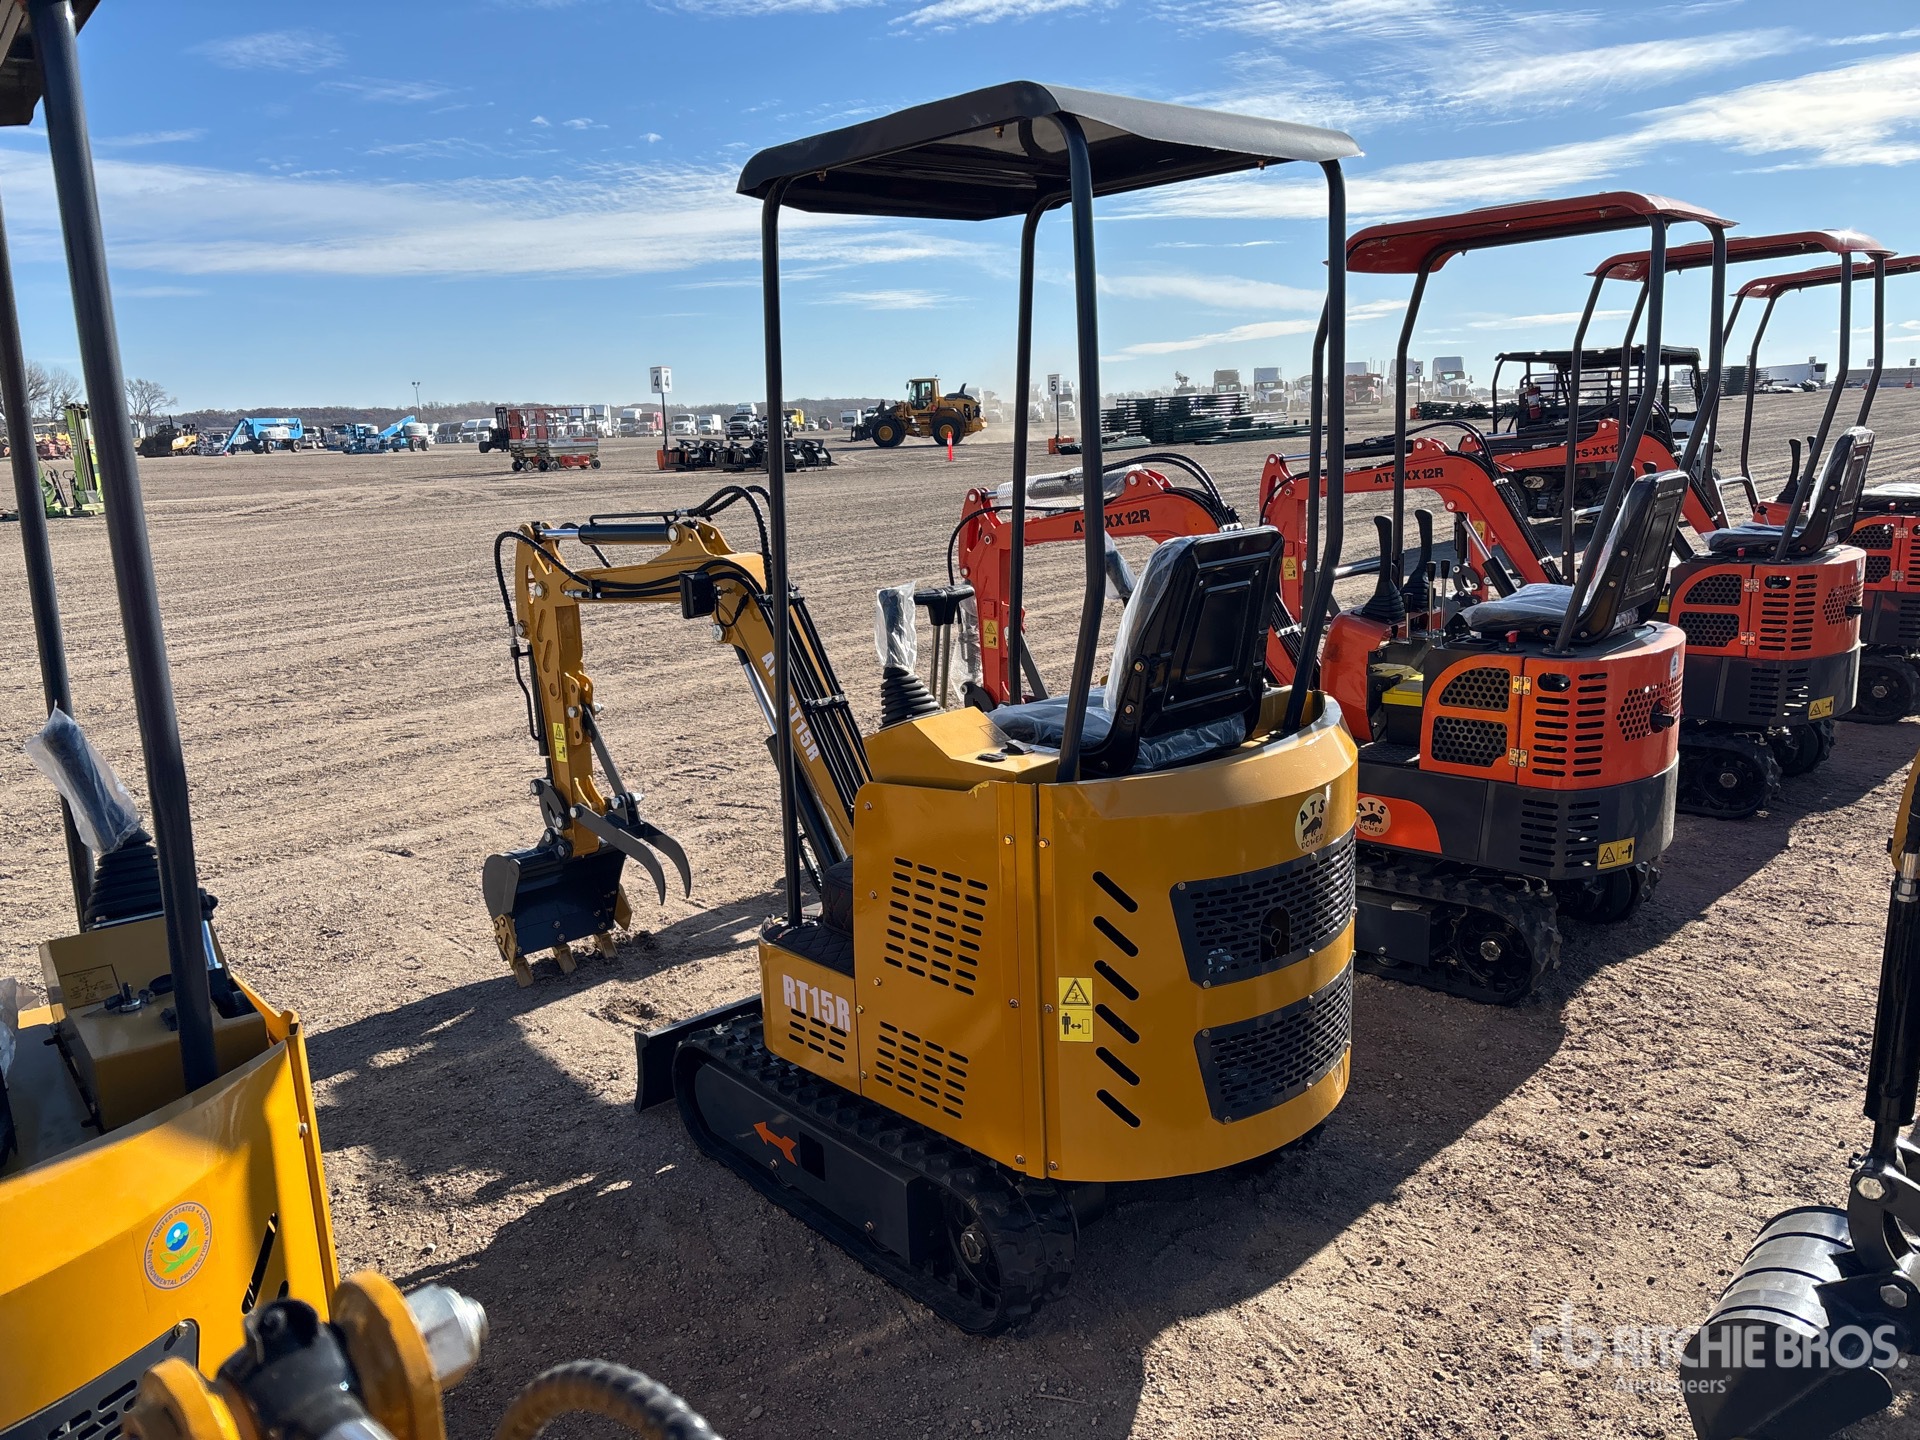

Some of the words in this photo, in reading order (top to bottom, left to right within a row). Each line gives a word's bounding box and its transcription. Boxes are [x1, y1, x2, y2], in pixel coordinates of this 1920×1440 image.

[1415, 365, 1420, 374] 6
[653, 375, 660, 389] 4
[664, 375, 670, 389] 4
[1050, 381, 1057, 391] 5
[1299, 799, 1326, 826] ATS
[1358, 802, 1386, 815] ATS
[782, 973, 851, 1032] RT15R
[153, 1213, 173, 1238] UNITED
[173, 1205, 196, 1216] STATES
[147, 1249, 177, 1286] ENVIRONMENTAL
[180, 1239, 209, 1281] PROTECTION
[199, 1211, 210, 1236] AGENCY
